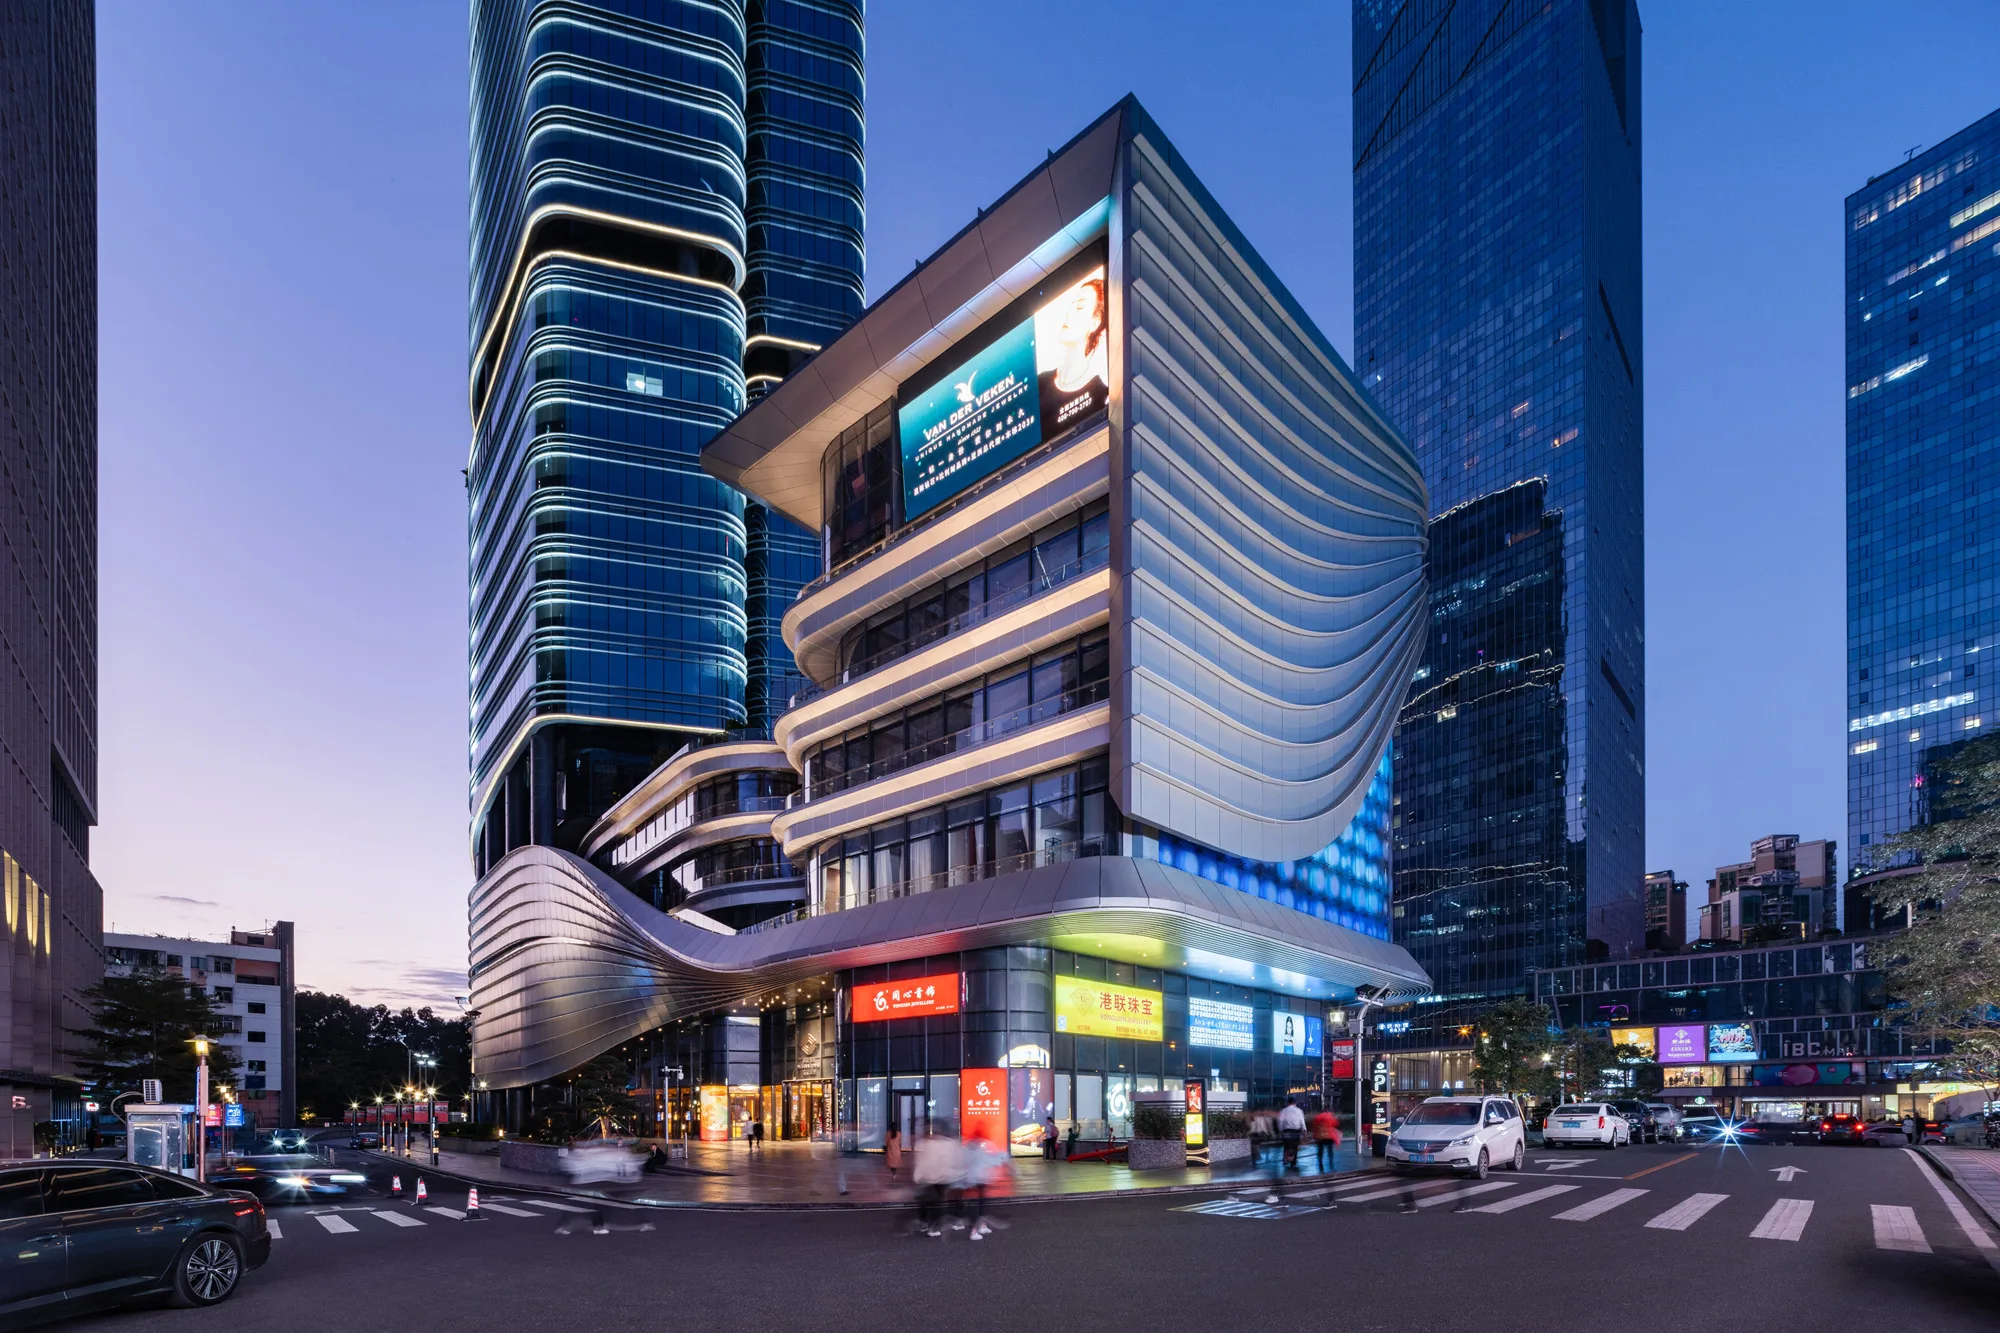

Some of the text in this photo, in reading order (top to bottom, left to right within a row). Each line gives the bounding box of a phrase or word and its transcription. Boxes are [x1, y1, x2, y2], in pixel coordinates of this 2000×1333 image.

[914, 384, 1029, 462] UNIQUE HANDMADE JEWELRY
[924, 374, 1015, 441] VAN DER VEKEN
[1099, 991, 1153, 1016] 港联珠宝
[1783, 1041, 1821, 1057] IBC
